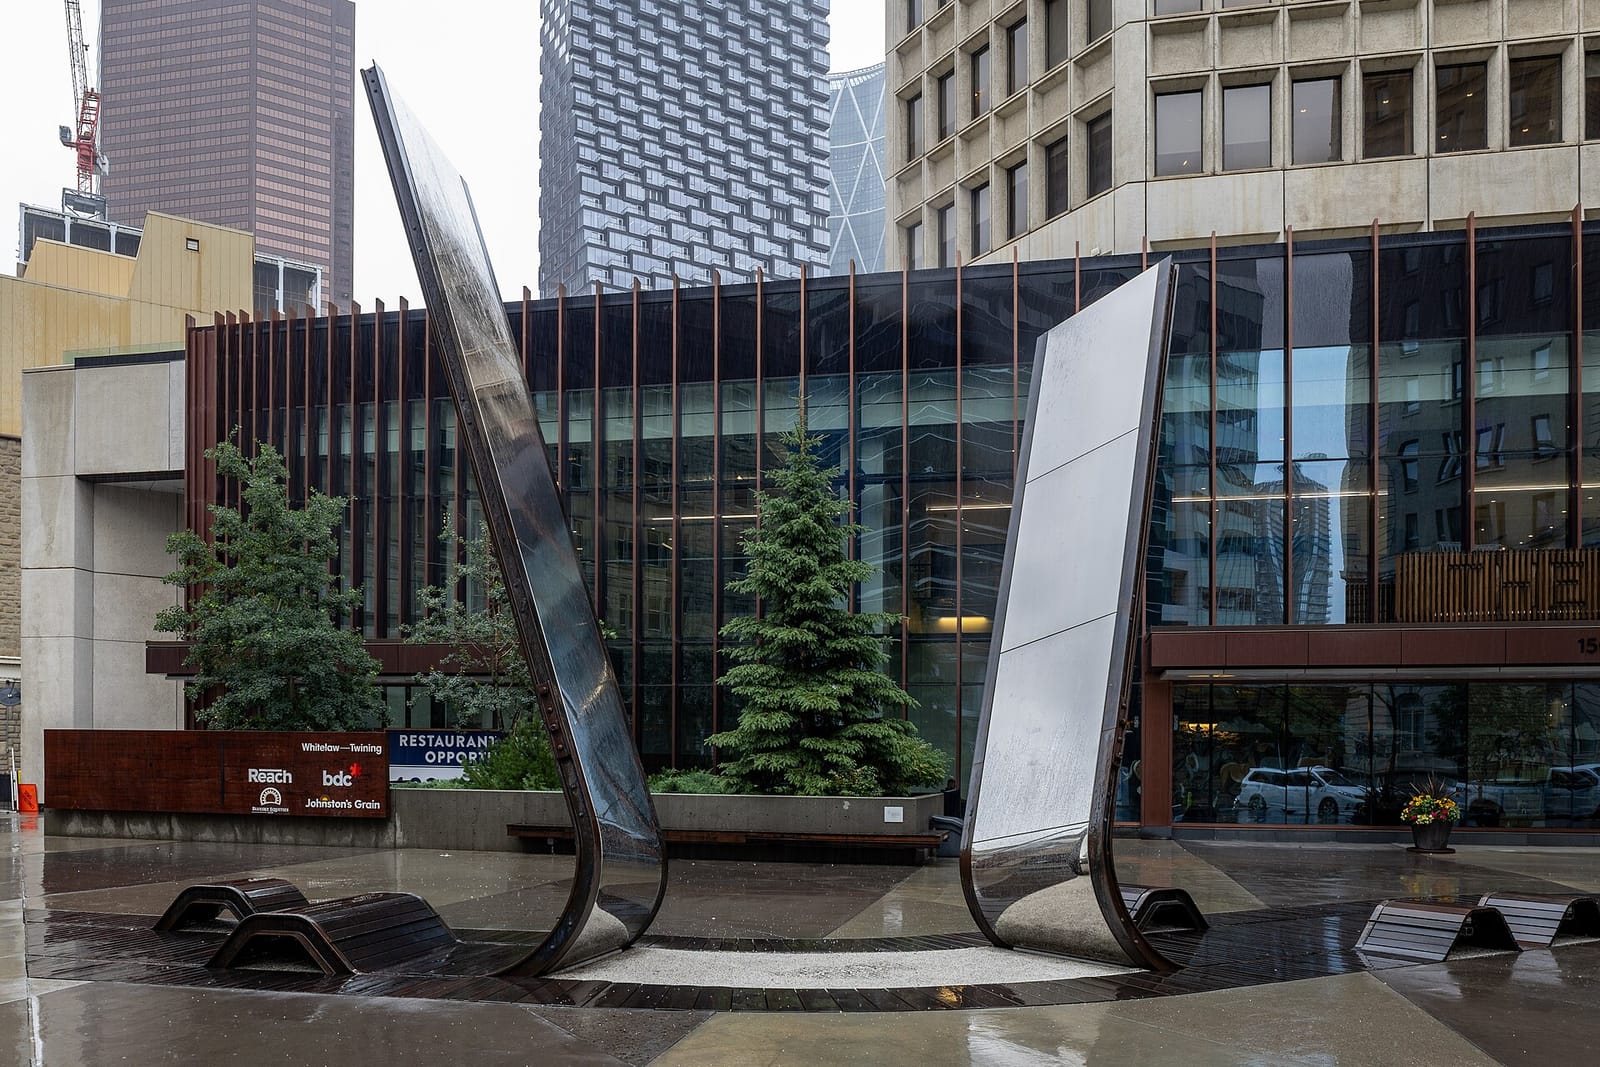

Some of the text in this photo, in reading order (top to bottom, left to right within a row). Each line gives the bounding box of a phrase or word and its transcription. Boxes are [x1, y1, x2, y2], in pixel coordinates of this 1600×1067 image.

[1577, 638, 1600, 654] 15
[248, 768, 292, 784] Reach
[322, 769, 353, 787] bdc
[305, 798, 381, 810] Johnston's Grain
